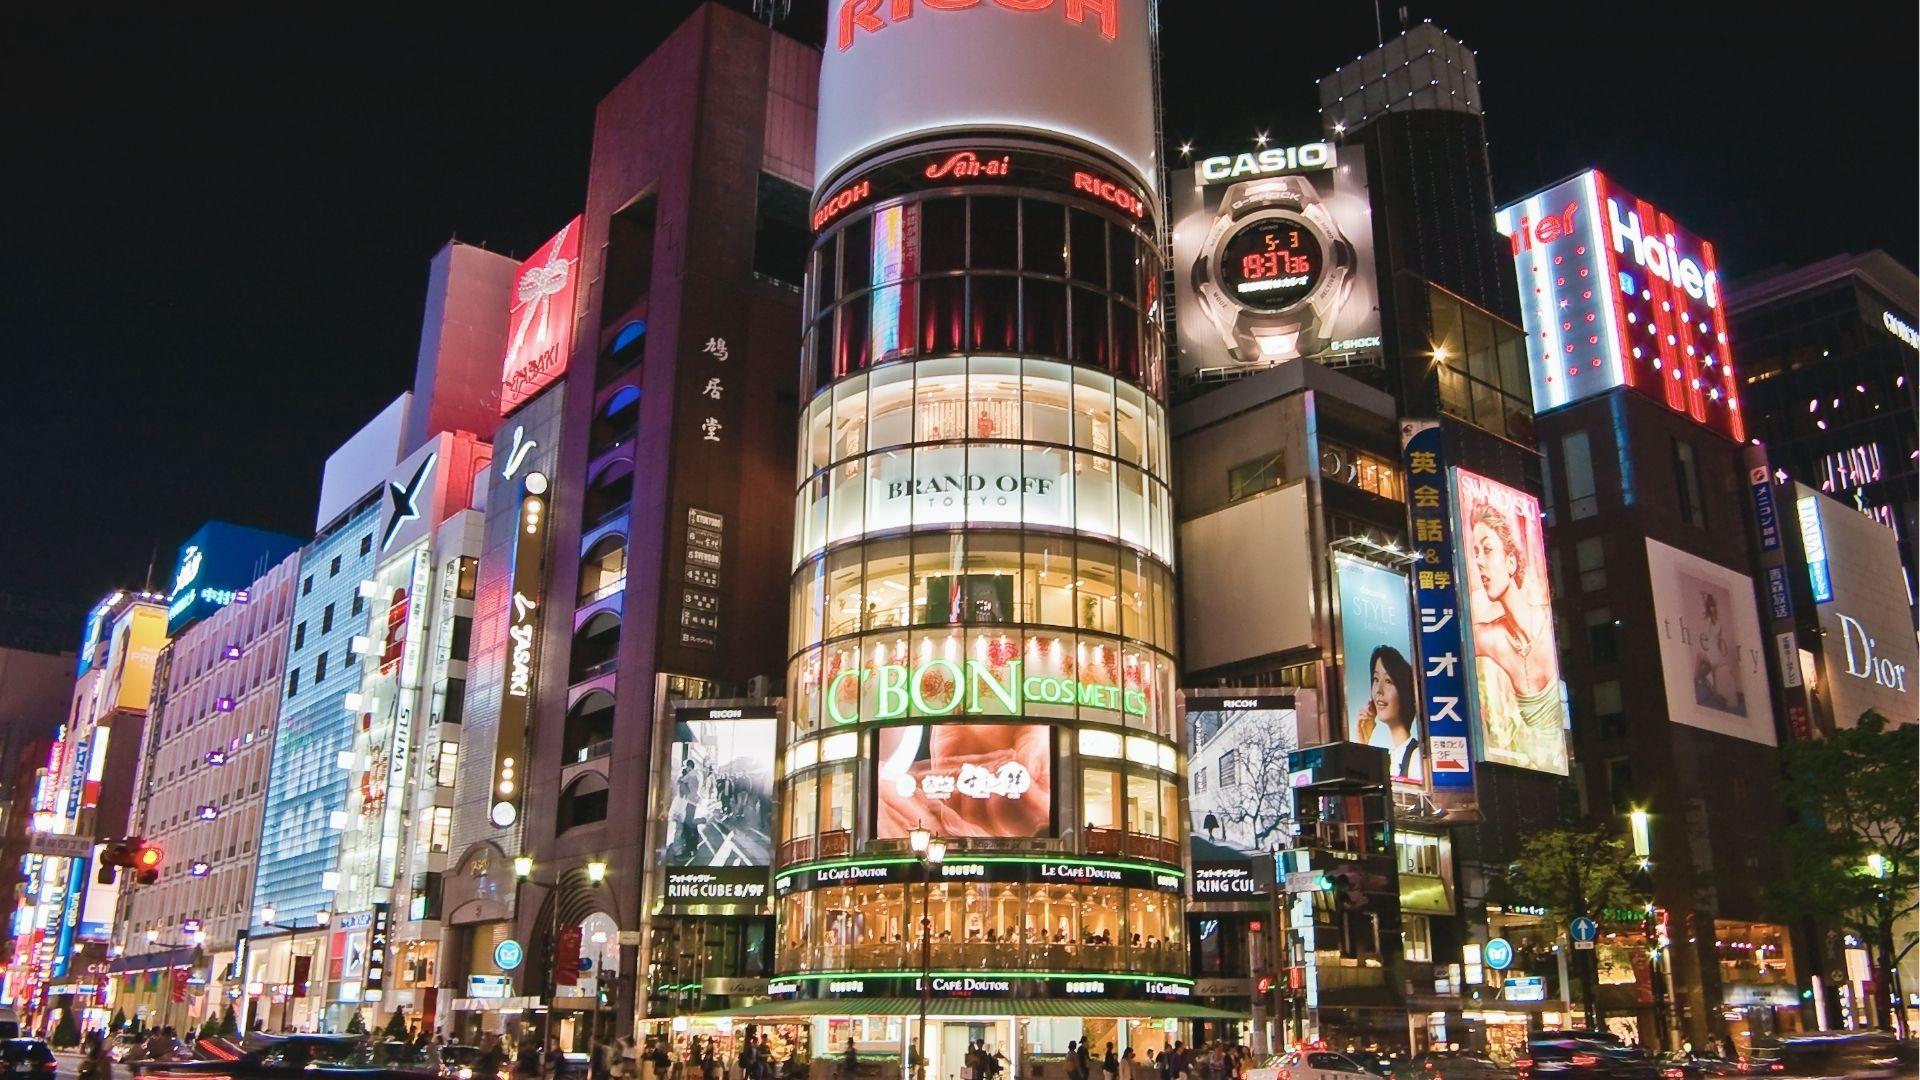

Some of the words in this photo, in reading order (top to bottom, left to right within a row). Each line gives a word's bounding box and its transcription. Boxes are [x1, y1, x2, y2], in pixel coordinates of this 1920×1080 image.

[926, 152, 1010, 180] San-ai
[1202, 142, 1328, 180] CASIO
[814, 181, 871, 232] RICOH
[1074, 171, 1144, 218] RICOH
[1231, 191, 1301, 210] G-SHOCK
[1607, 198, 1718, 309] Haier
[1330, 335, 1381, 351] G-SHOCK
[702, 337, 729, 442] 鳩居堂
[888, 474, 985, 500] BRAND
[995, 474, 1054, 495] OFF
[1410, 451, 1444, 543] 英会話
[1425, 548, 1440, 565] &
[1418, 570, 1452, 591] 留学
[1352, 596, 1396, 626] STYLE
[510, 624, 534, 697] TASAKI
[1421, 608, 1463, 722] ジオス
[1835, 612, 1906, 693] Dior
[829, 658, 1022, 726] C'BON
[1023, 676, 1148, 715] COSMETCS
[1223, 699, 1258, 708] RICOH
[709, 709, 742, 719] RICOH
[394, 708, 410, 773] SHIMA
[668, 884, 699, 897] RING
[700, 884, 733, 897] CUBE
[1196, 879, 1230, 893] RING
